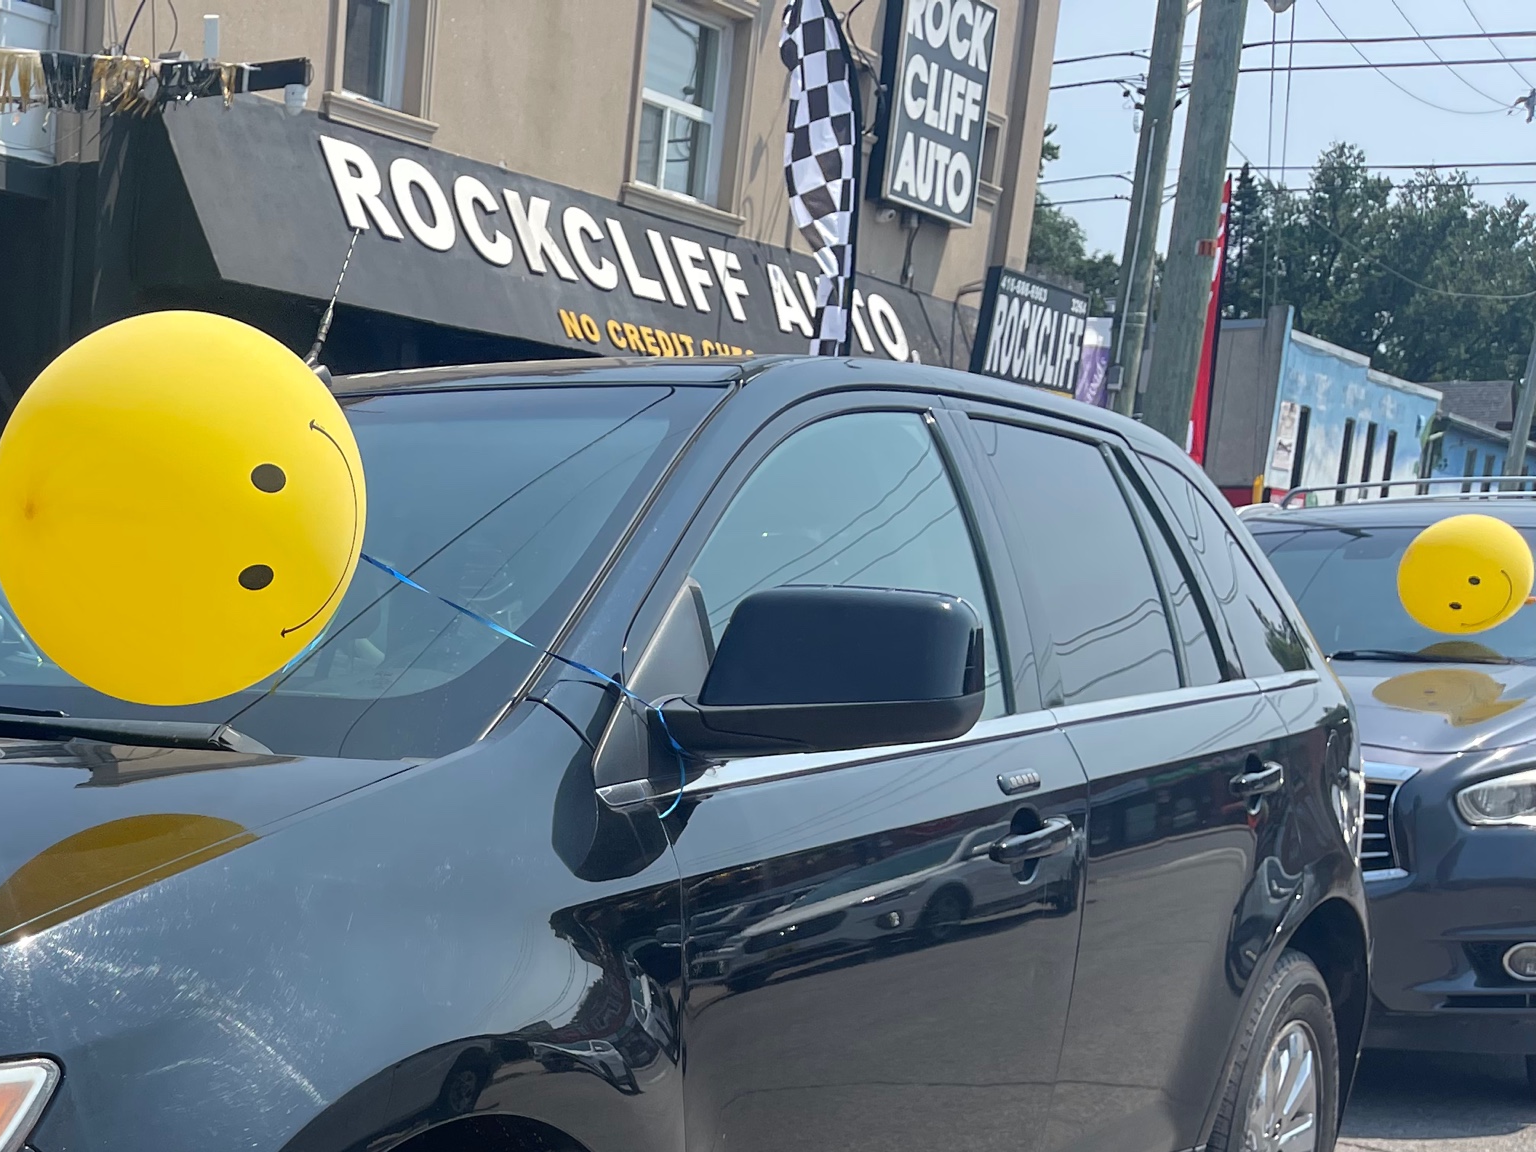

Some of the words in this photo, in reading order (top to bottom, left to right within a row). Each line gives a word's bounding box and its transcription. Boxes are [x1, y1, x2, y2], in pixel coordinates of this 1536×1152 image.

[906, 0, 995, 72] ROCK
[904, 54, 983, 141] CLIFF
[893, 131, 972, 214] AUTO
[320, 135, 750, 322] ROCKCLIFF
[559, 308, 602, 344] NO
[606, 319, 694, 357] CREDIT
[985, 294, 1084, 389] ROCKCLIFF
